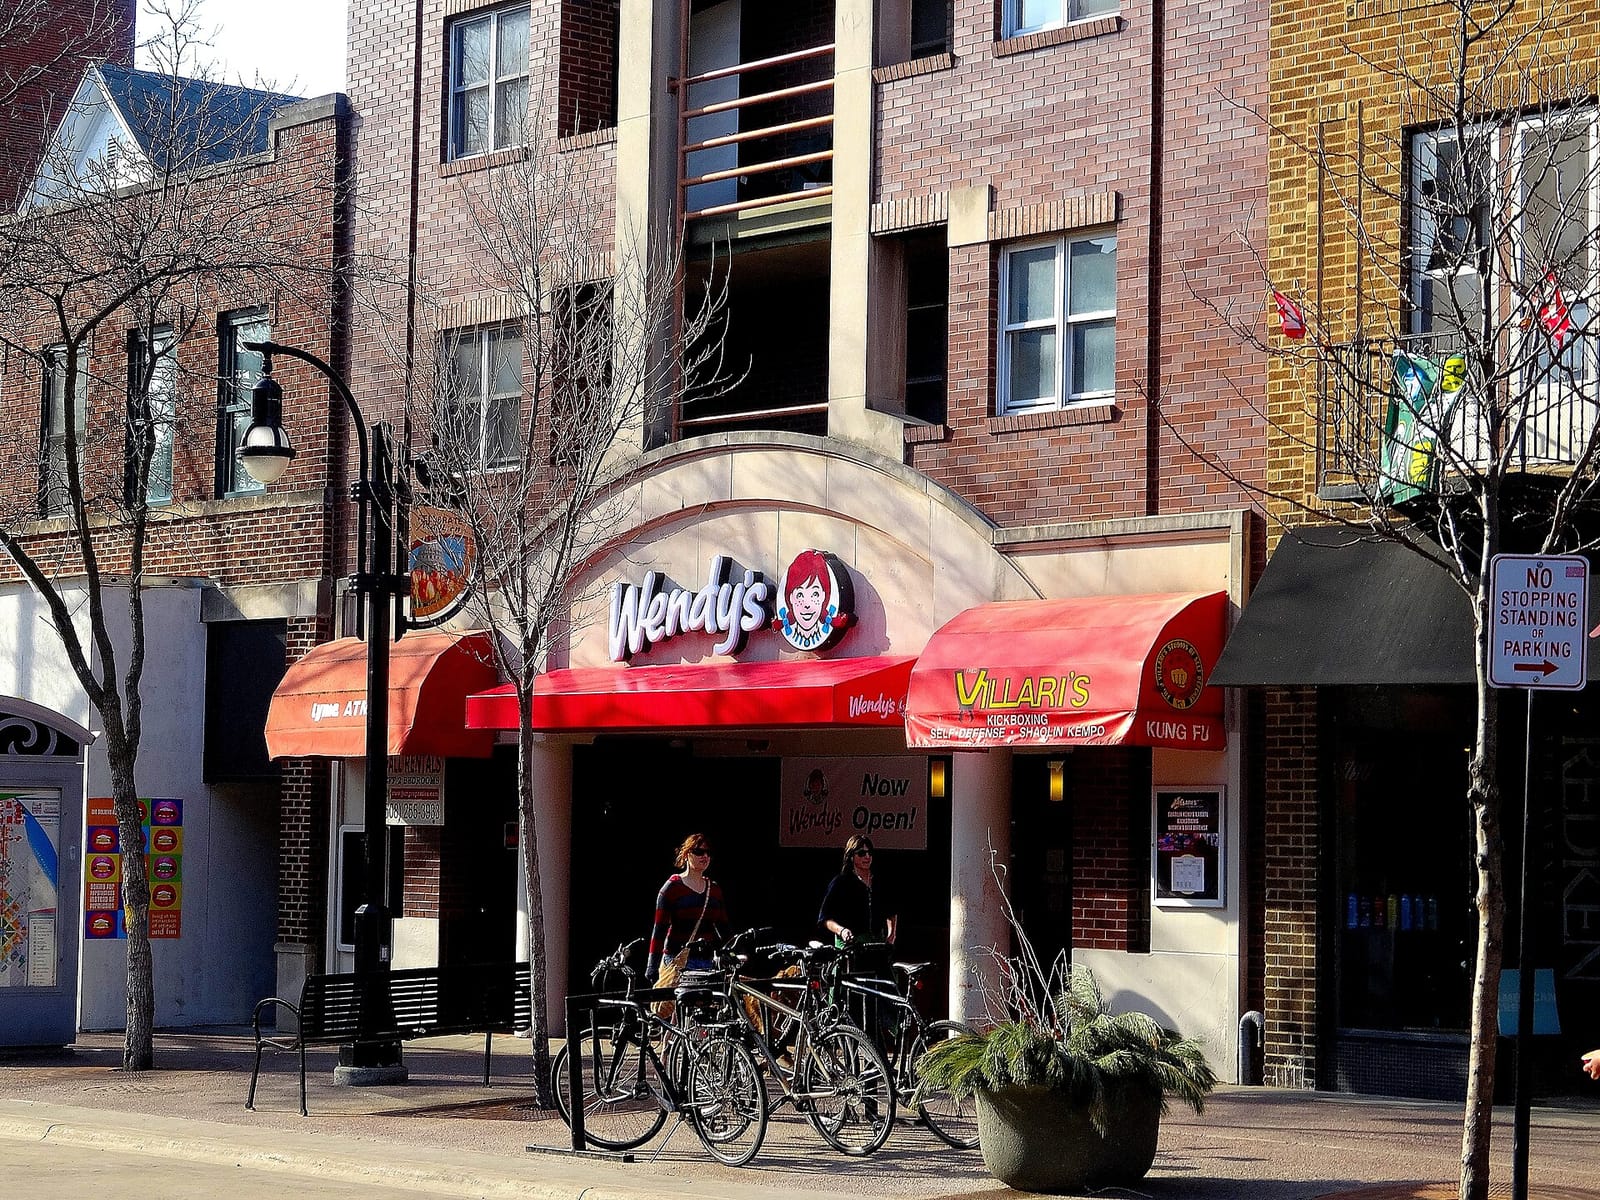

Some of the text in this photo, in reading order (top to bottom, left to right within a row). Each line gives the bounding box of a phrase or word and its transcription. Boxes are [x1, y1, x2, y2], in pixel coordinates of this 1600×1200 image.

[1526, 567, 1553, 588] NO
[609, 554, 768, 662] Wendy's
[1501, 591, 1577, 608] STOPPING
[1500, 609, 1577, 627] STANDING
[1531, 628, 1544, 638] OR
[1503, 640, 1571, 658] PARKING
[955, 668, 1091, 709] VILLARI'S
[849, 692, 896, 719] Wendy's
[986, 714, 1048, 726] KICKBOXING
[1019, 726, 1063, 738] SHAOLIN
[1067, 725, 1105, 737] KEMPO
[1146, 720, 1210, 742] KUNG FU
[404, 755, 441, 773] RENTALS
[403, 775, 440, 785] BEDROOMS
[861, 772, 911, 797] Now
[789, 806, 842, 835] Wendy's
[852, 806, 918, 834] Open!
